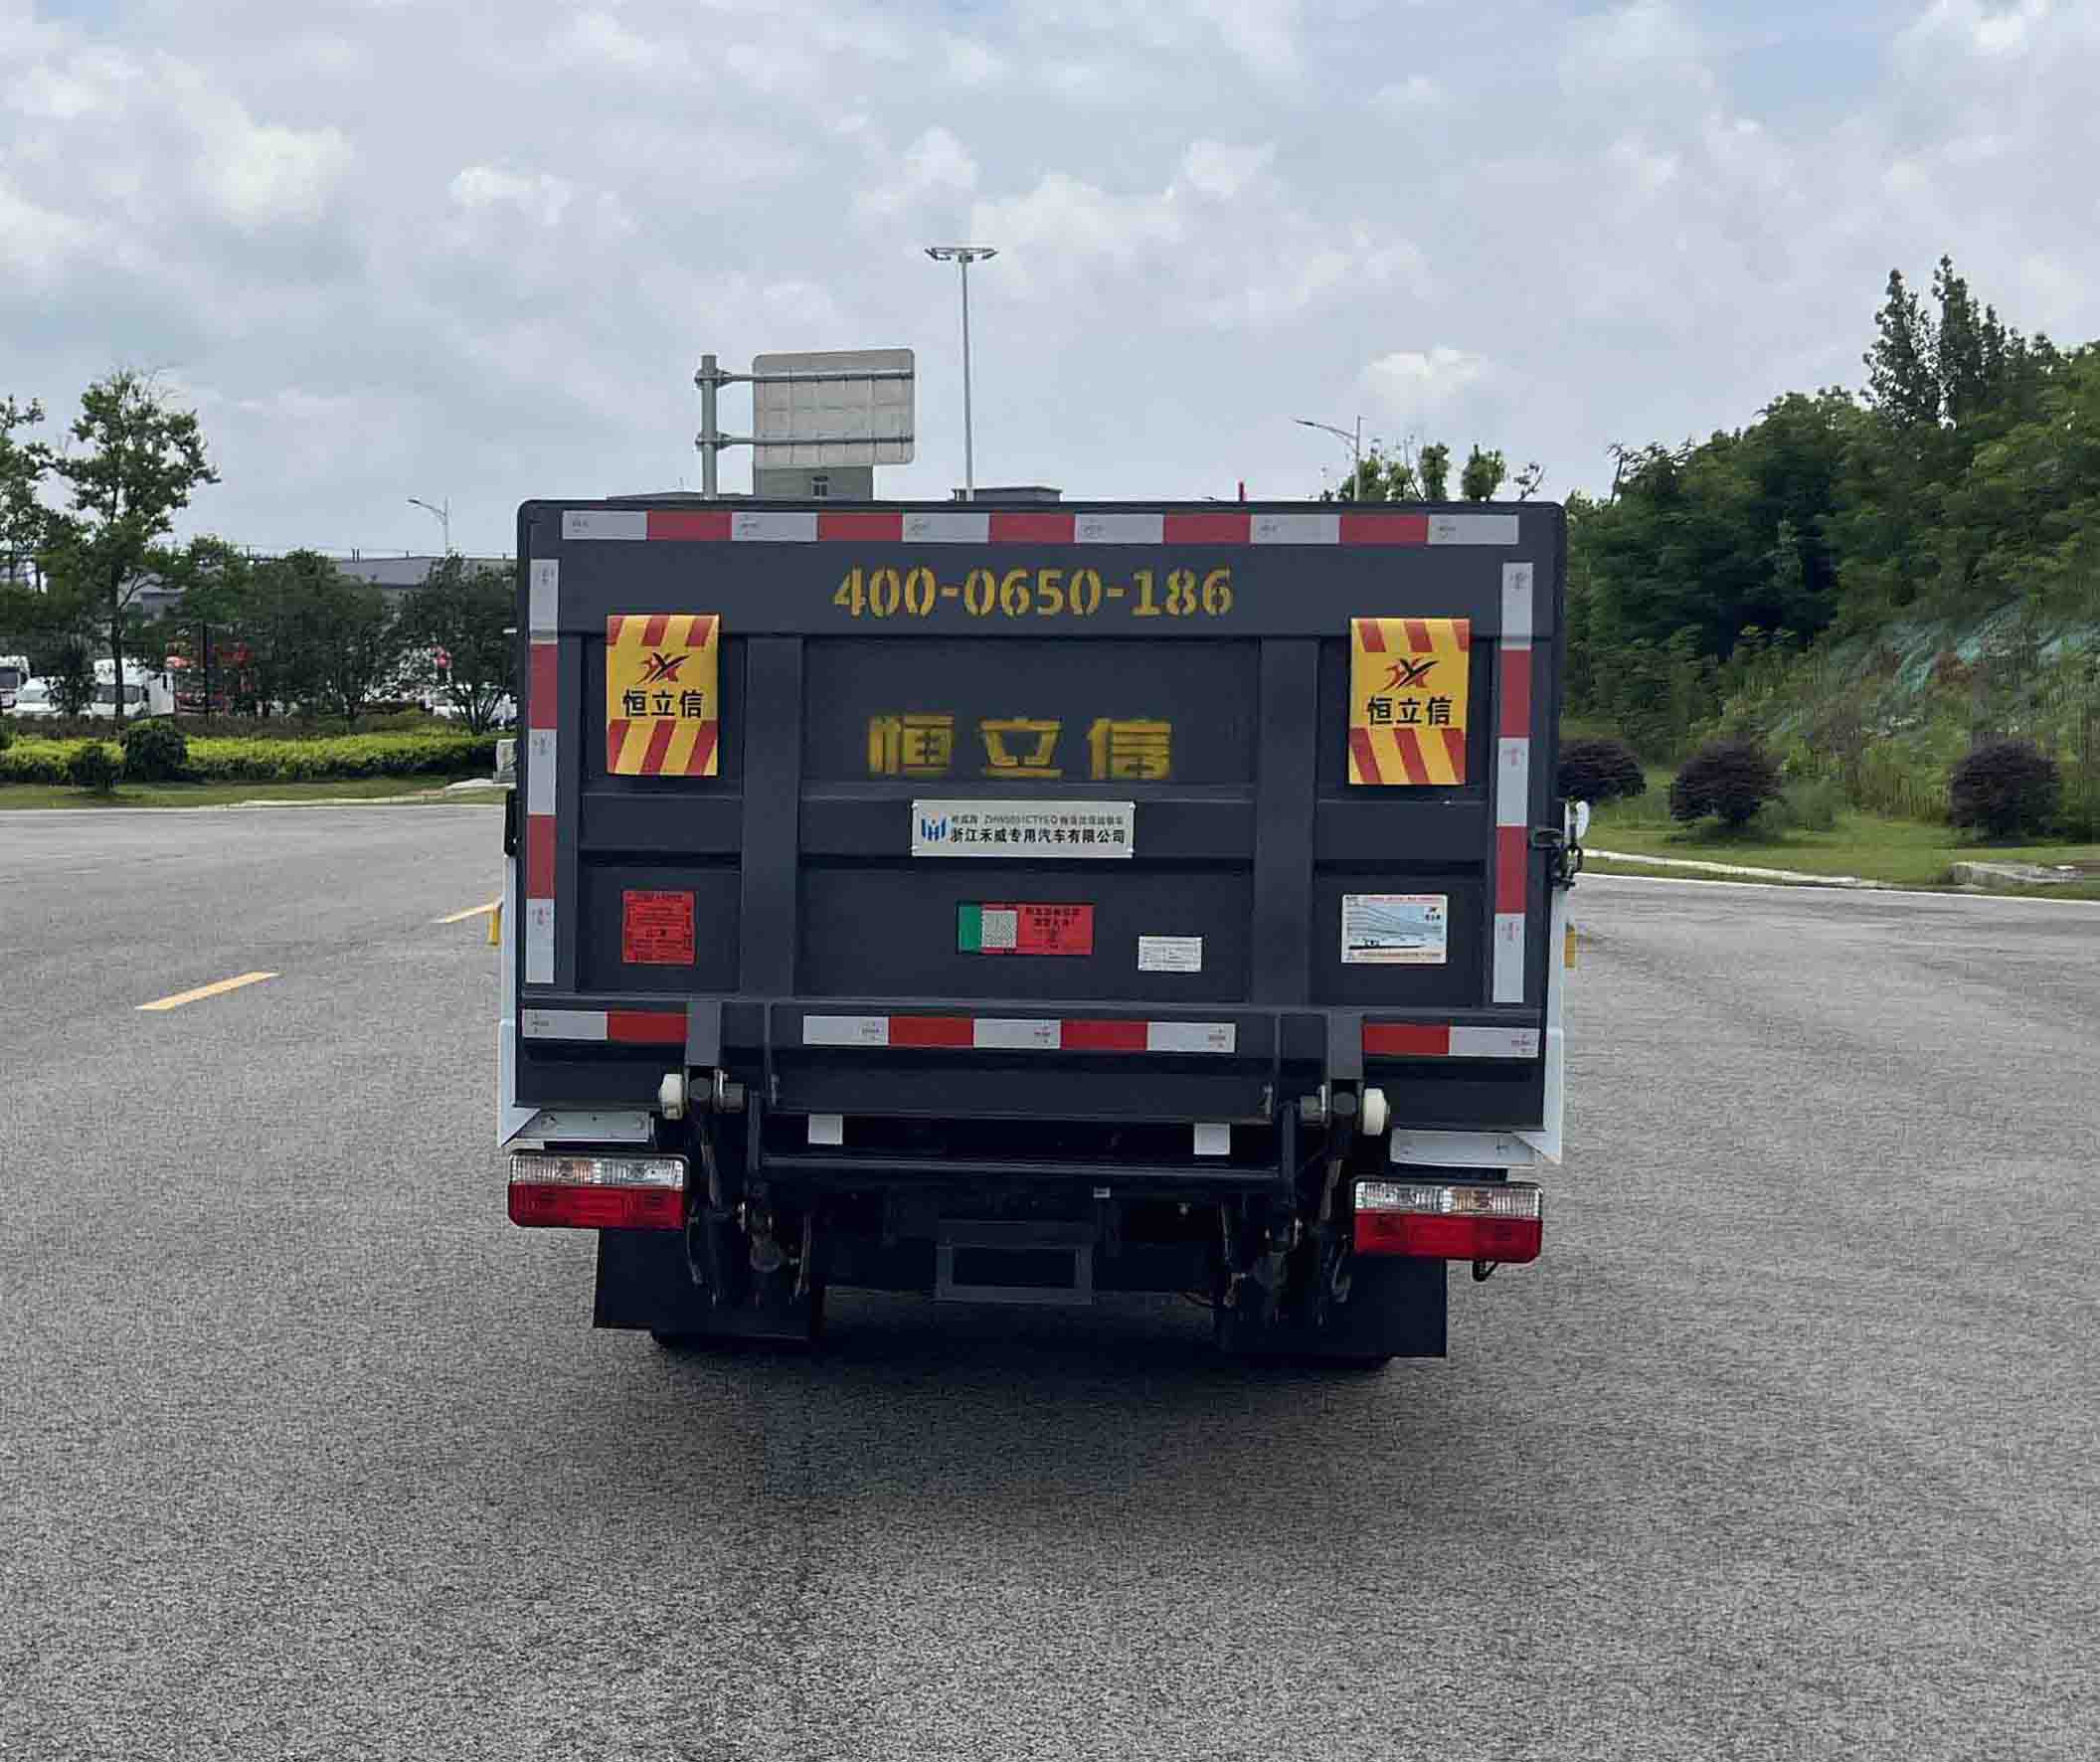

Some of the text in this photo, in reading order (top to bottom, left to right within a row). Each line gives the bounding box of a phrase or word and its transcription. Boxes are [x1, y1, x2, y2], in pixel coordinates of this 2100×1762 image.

[834, 566, 1233, 617] 400-0650-186
[622, 689, 703, 718] 恒立信
[1367, 696, 1452, 725] 恒立信
[868, 715, 1172, 780] 恒立信
